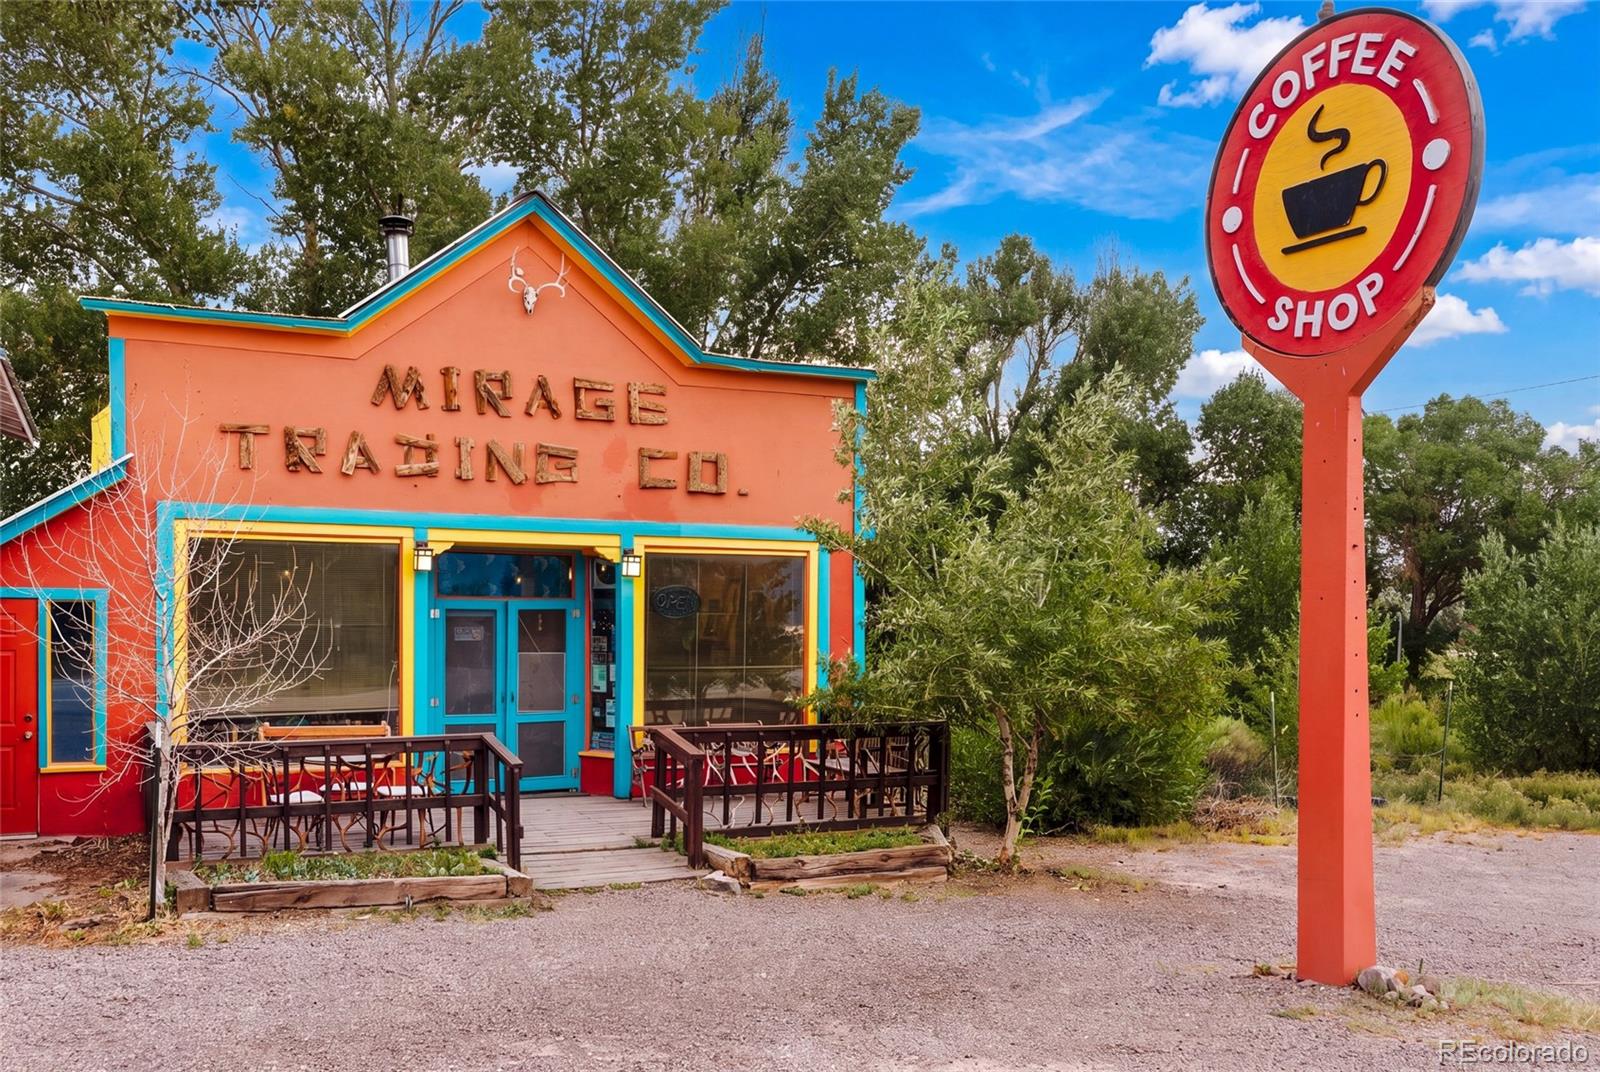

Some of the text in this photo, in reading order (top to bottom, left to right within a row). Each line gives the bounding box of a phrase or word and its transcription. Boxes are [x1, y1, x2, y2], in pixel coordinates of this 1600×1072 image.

[1248, 32, 1417, 139] COFFEE
[1267, 272, 1384, 338] SHOP
[371, 363, 668, 425] MIRAGE
[219, 423, 749, 496] TRADING CO.
[656, 592, 696, 610] OPE
